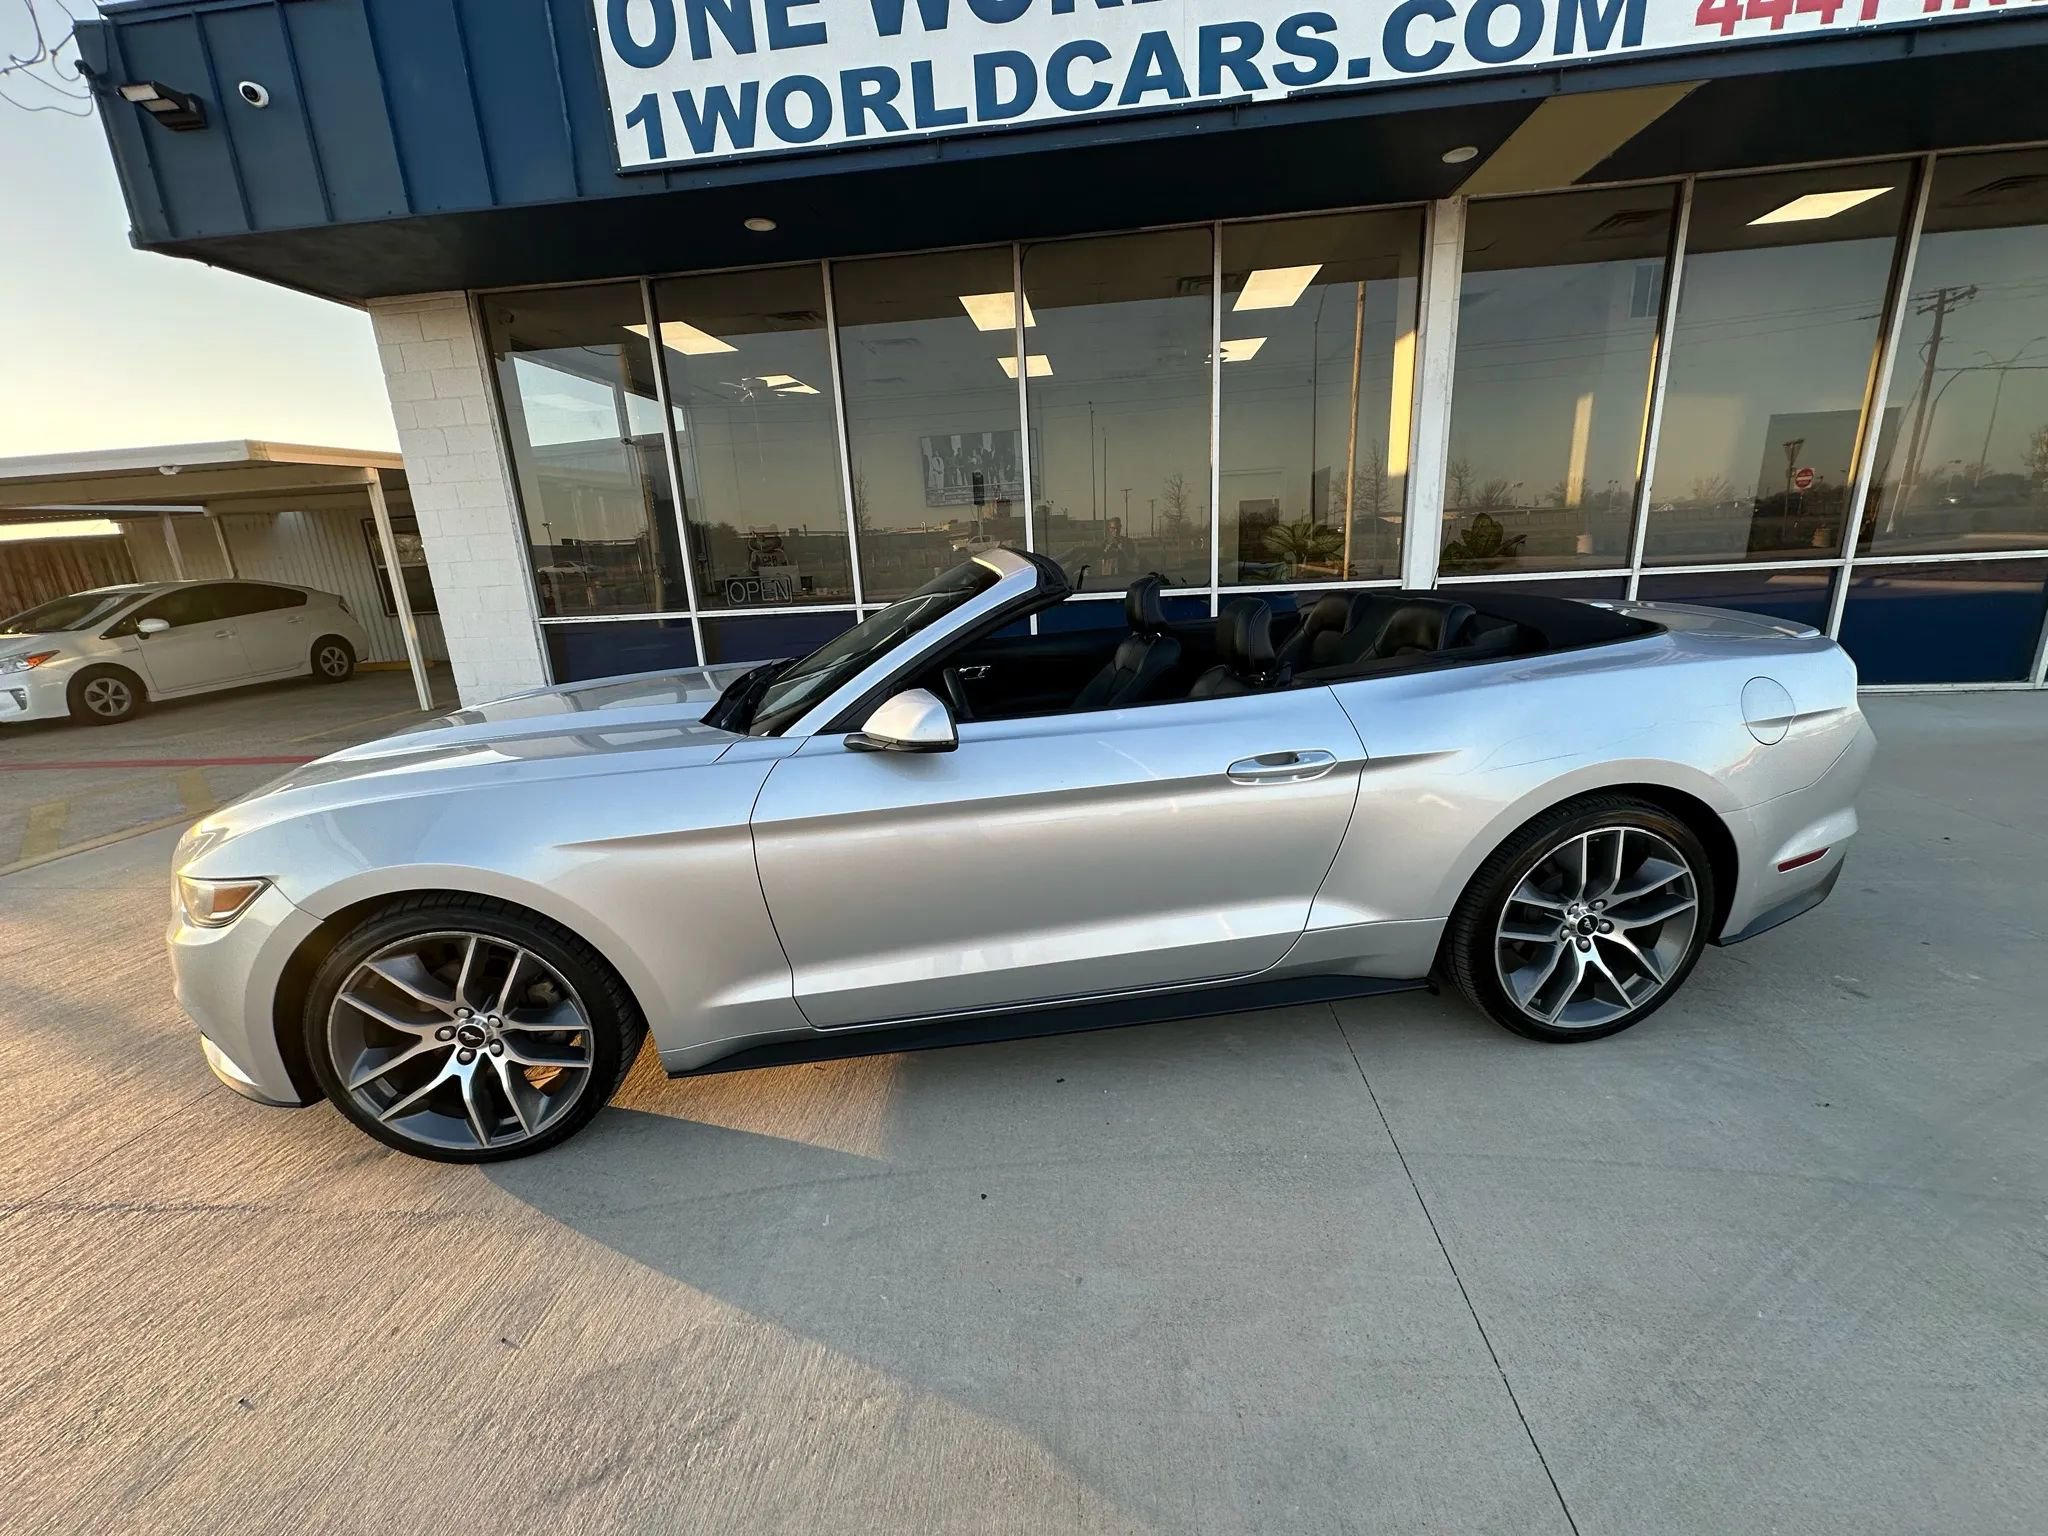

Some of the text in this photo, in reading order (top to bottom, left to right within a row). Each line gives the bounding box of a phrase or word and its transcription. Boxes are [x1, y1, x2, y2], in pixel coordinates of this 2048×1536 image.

[606, 0, 829, 69] ONE
[626, 0, 1648, 160] 1WORLDCARS.COM
[730, 579, 789, 603] OPEN
